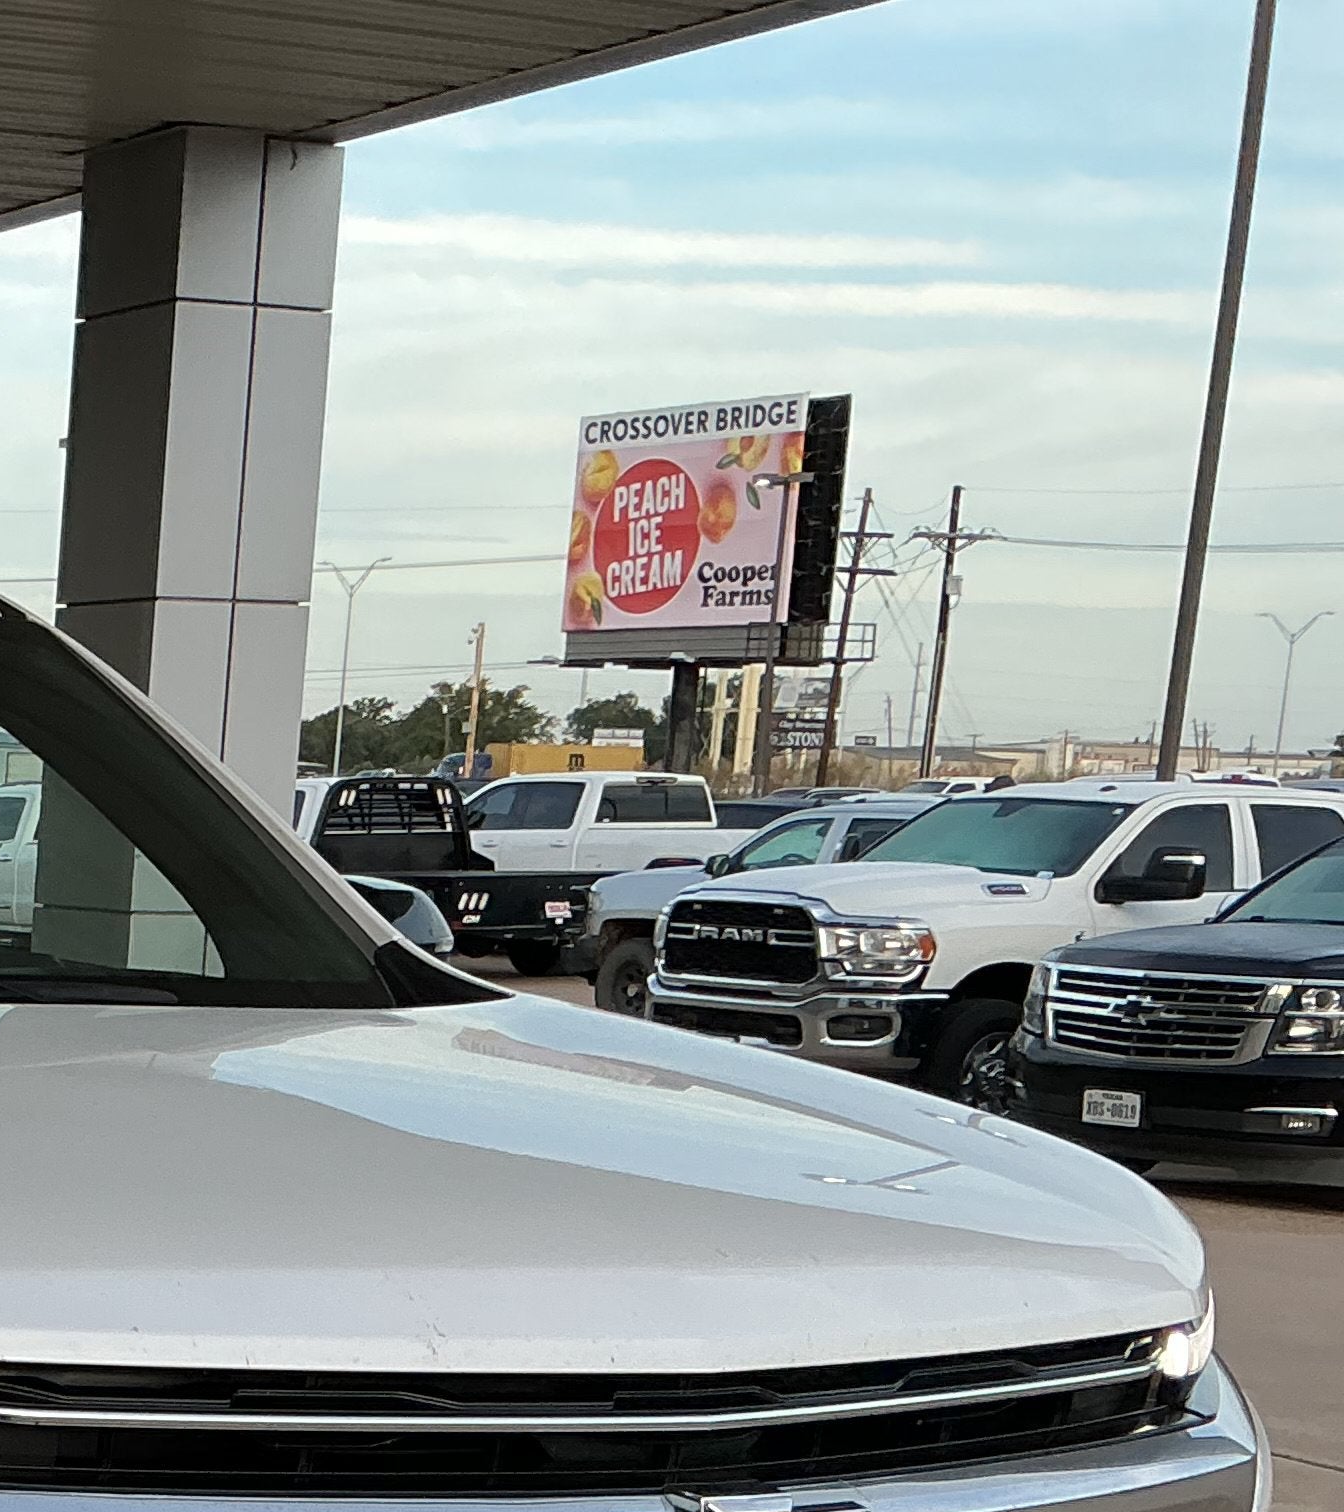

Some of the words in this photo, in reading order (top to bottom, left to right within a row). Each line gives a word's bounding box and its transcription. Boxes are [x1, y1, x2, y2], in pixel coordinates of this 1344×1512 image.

[584, 410, 709, 444] CROSSOVER
[716, 400, 798, 431] BRIDGE
[613, 472, 686, 523] PEACH
[628, 515, 663, 557] ICE
[606, 549, 683, 598] CREAM
[700, 585, 775, 607] Farms
[700, 926, 764, 941] RAM
